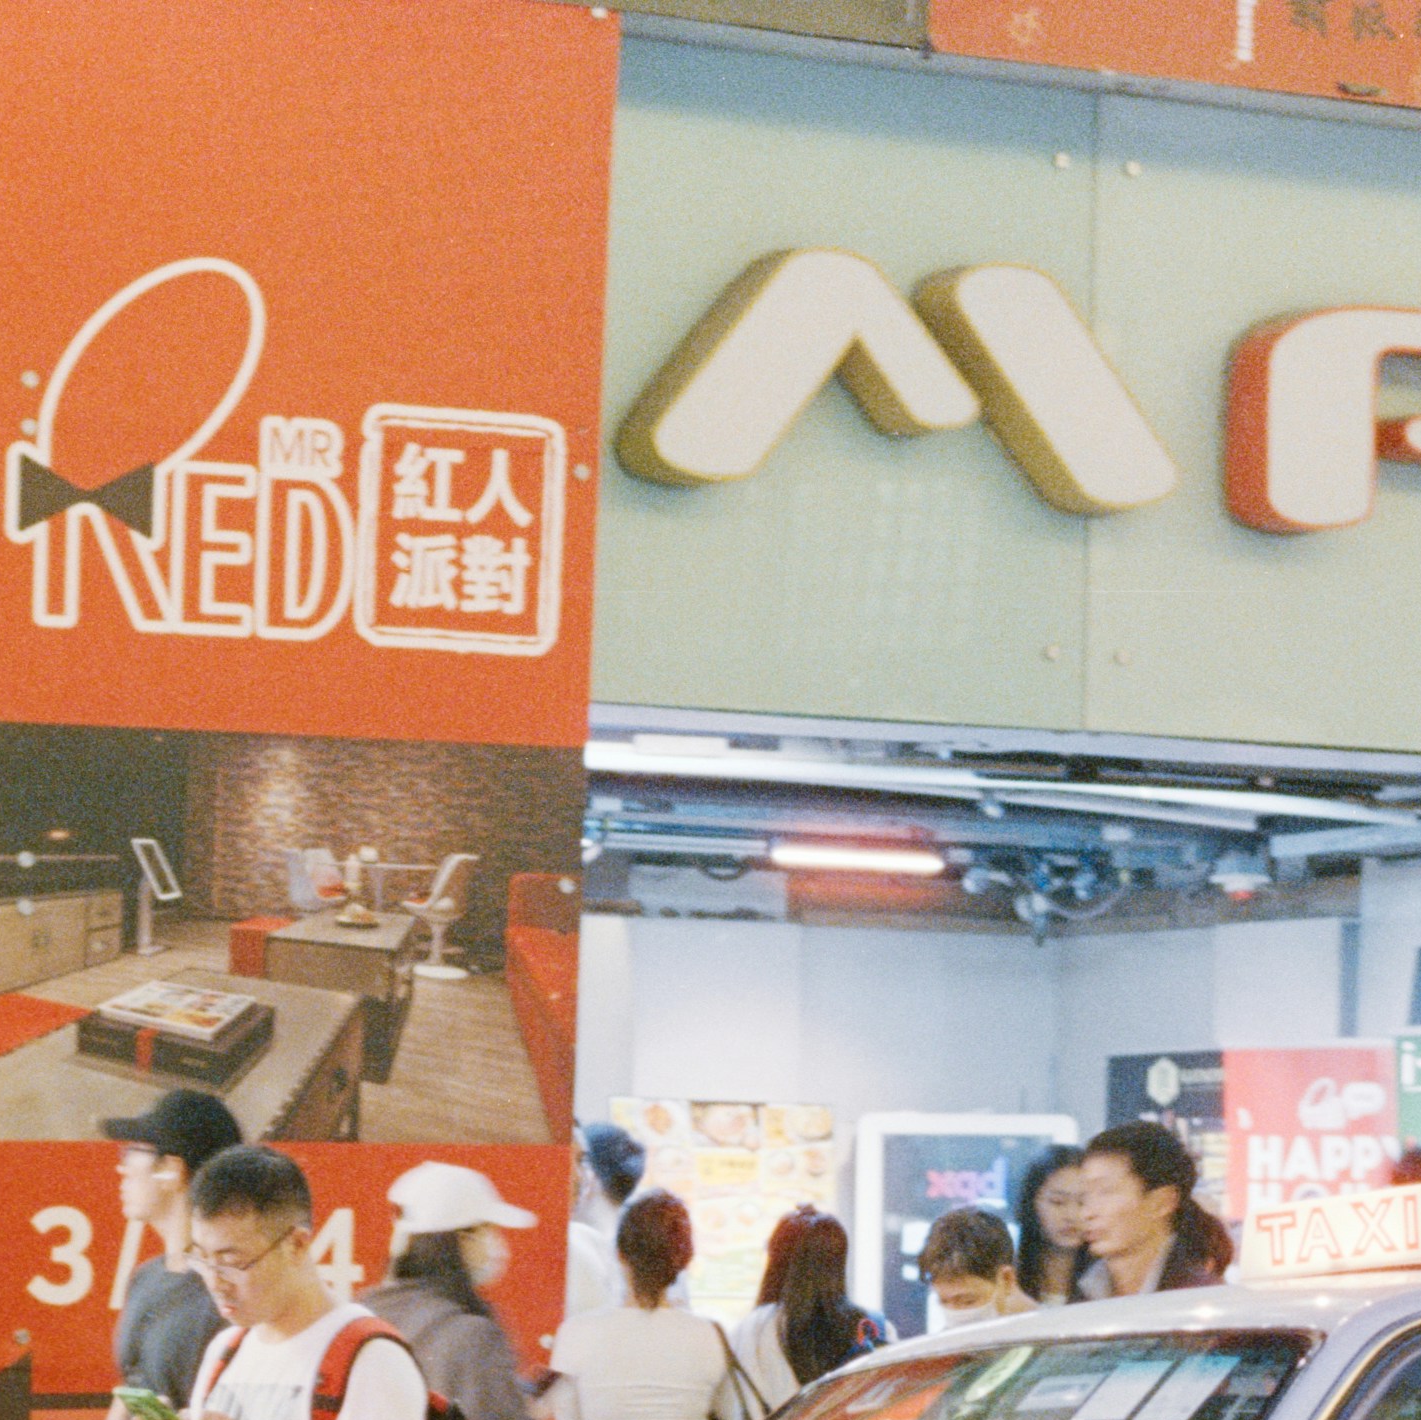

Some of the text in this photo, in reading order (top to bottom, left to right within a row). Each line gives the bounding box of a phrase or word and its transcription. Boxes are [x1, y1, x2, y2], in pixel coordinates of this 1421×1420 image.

[268, 424, 337, 470] MR
[391, 440, 534, 528] 紅人
[5, 410, 358, 641] RED
[388, 532, 533, 616] 派對
[1255, 1194, 1420, 1266] TAXI
